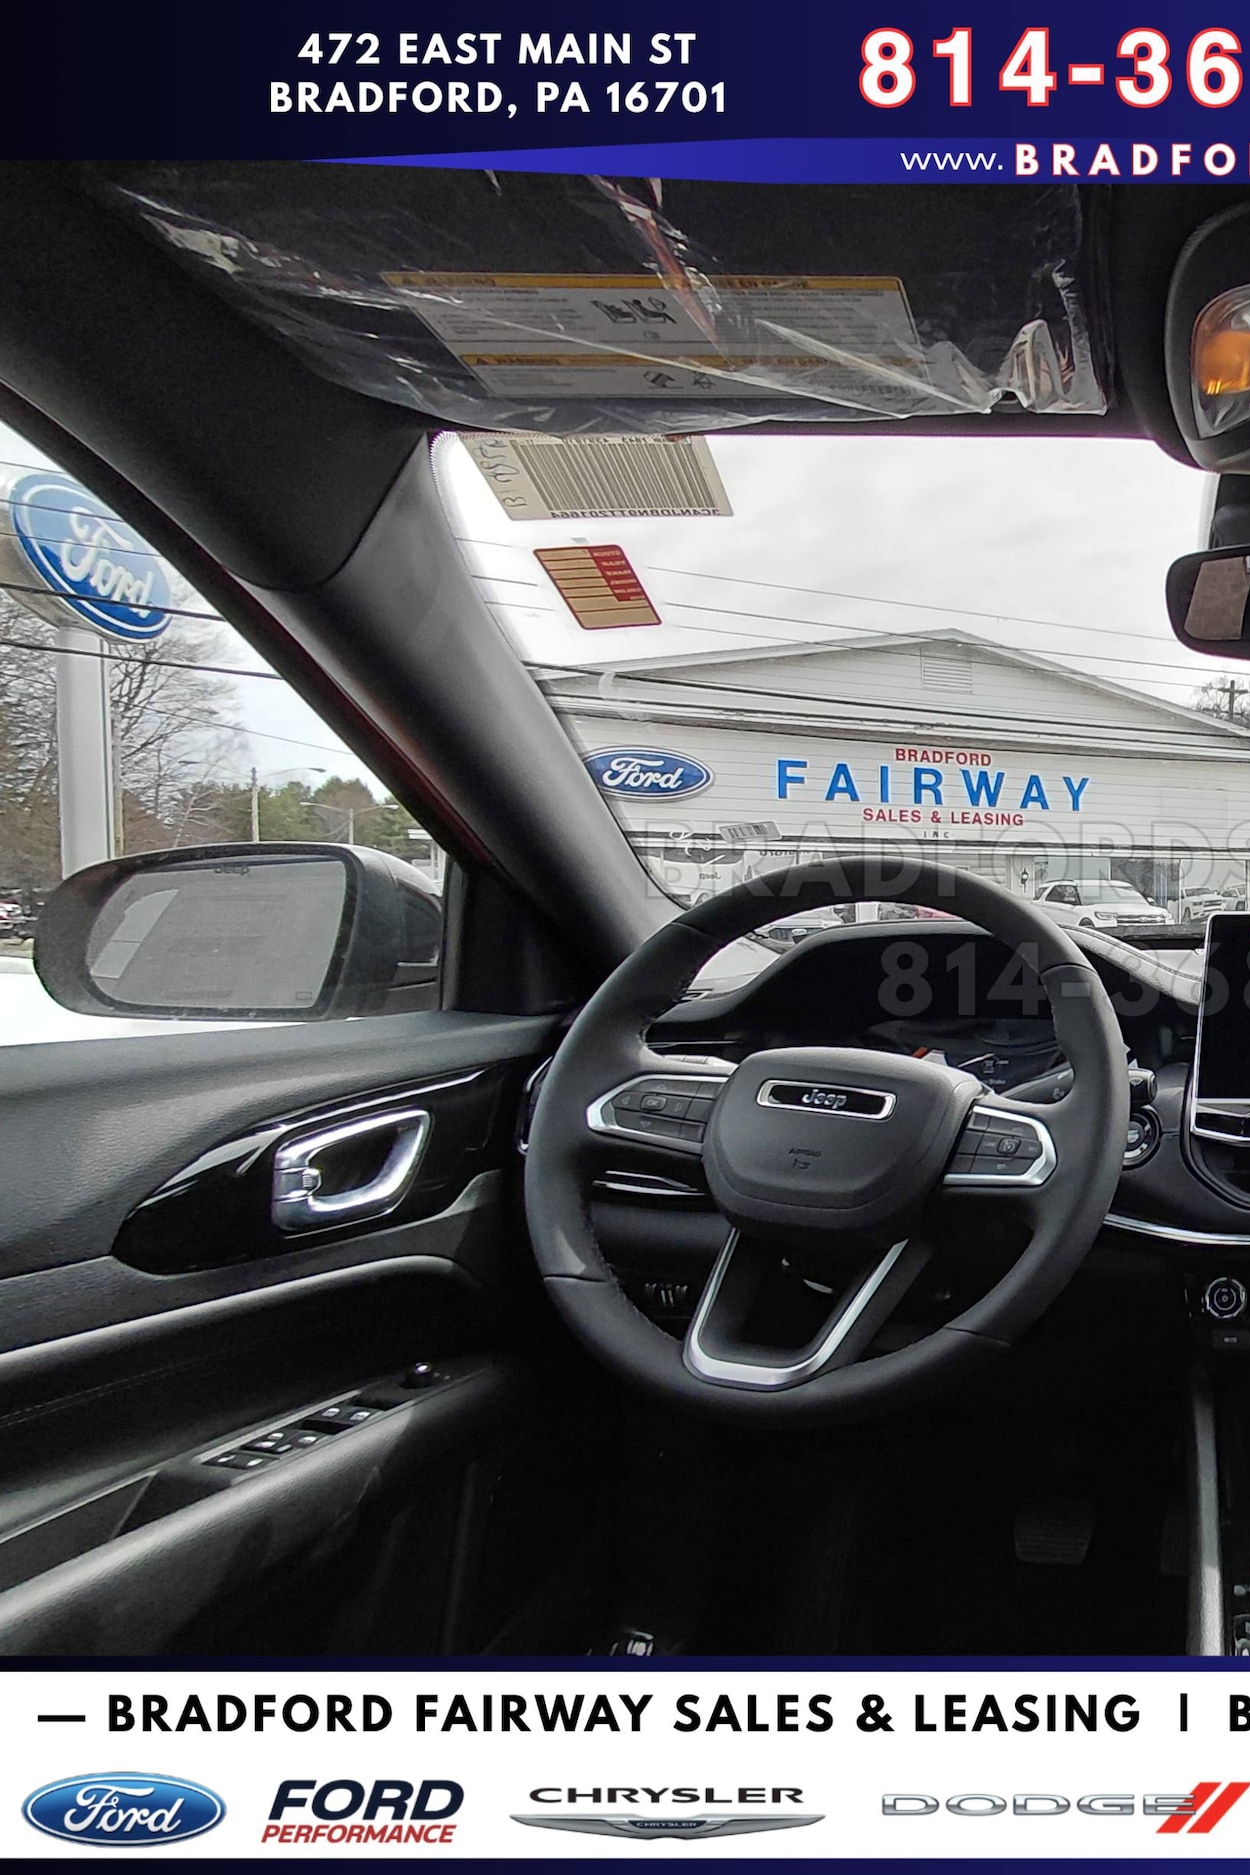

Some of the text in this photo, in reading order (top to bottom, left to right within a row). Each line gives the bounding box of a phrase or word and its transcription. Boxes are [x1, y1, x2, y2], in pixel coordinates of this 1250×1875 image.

[60, 505, 154, 619] Ford
[895, 747, 992, 767] BRADFORD
[601, 756, 686, 791] Ford
[776, 758, 1091, 812] FAIRWAY
[862, 807, 1024, 827] SALES & LEASING
[801, 1088, 848, 1110] Jeep
